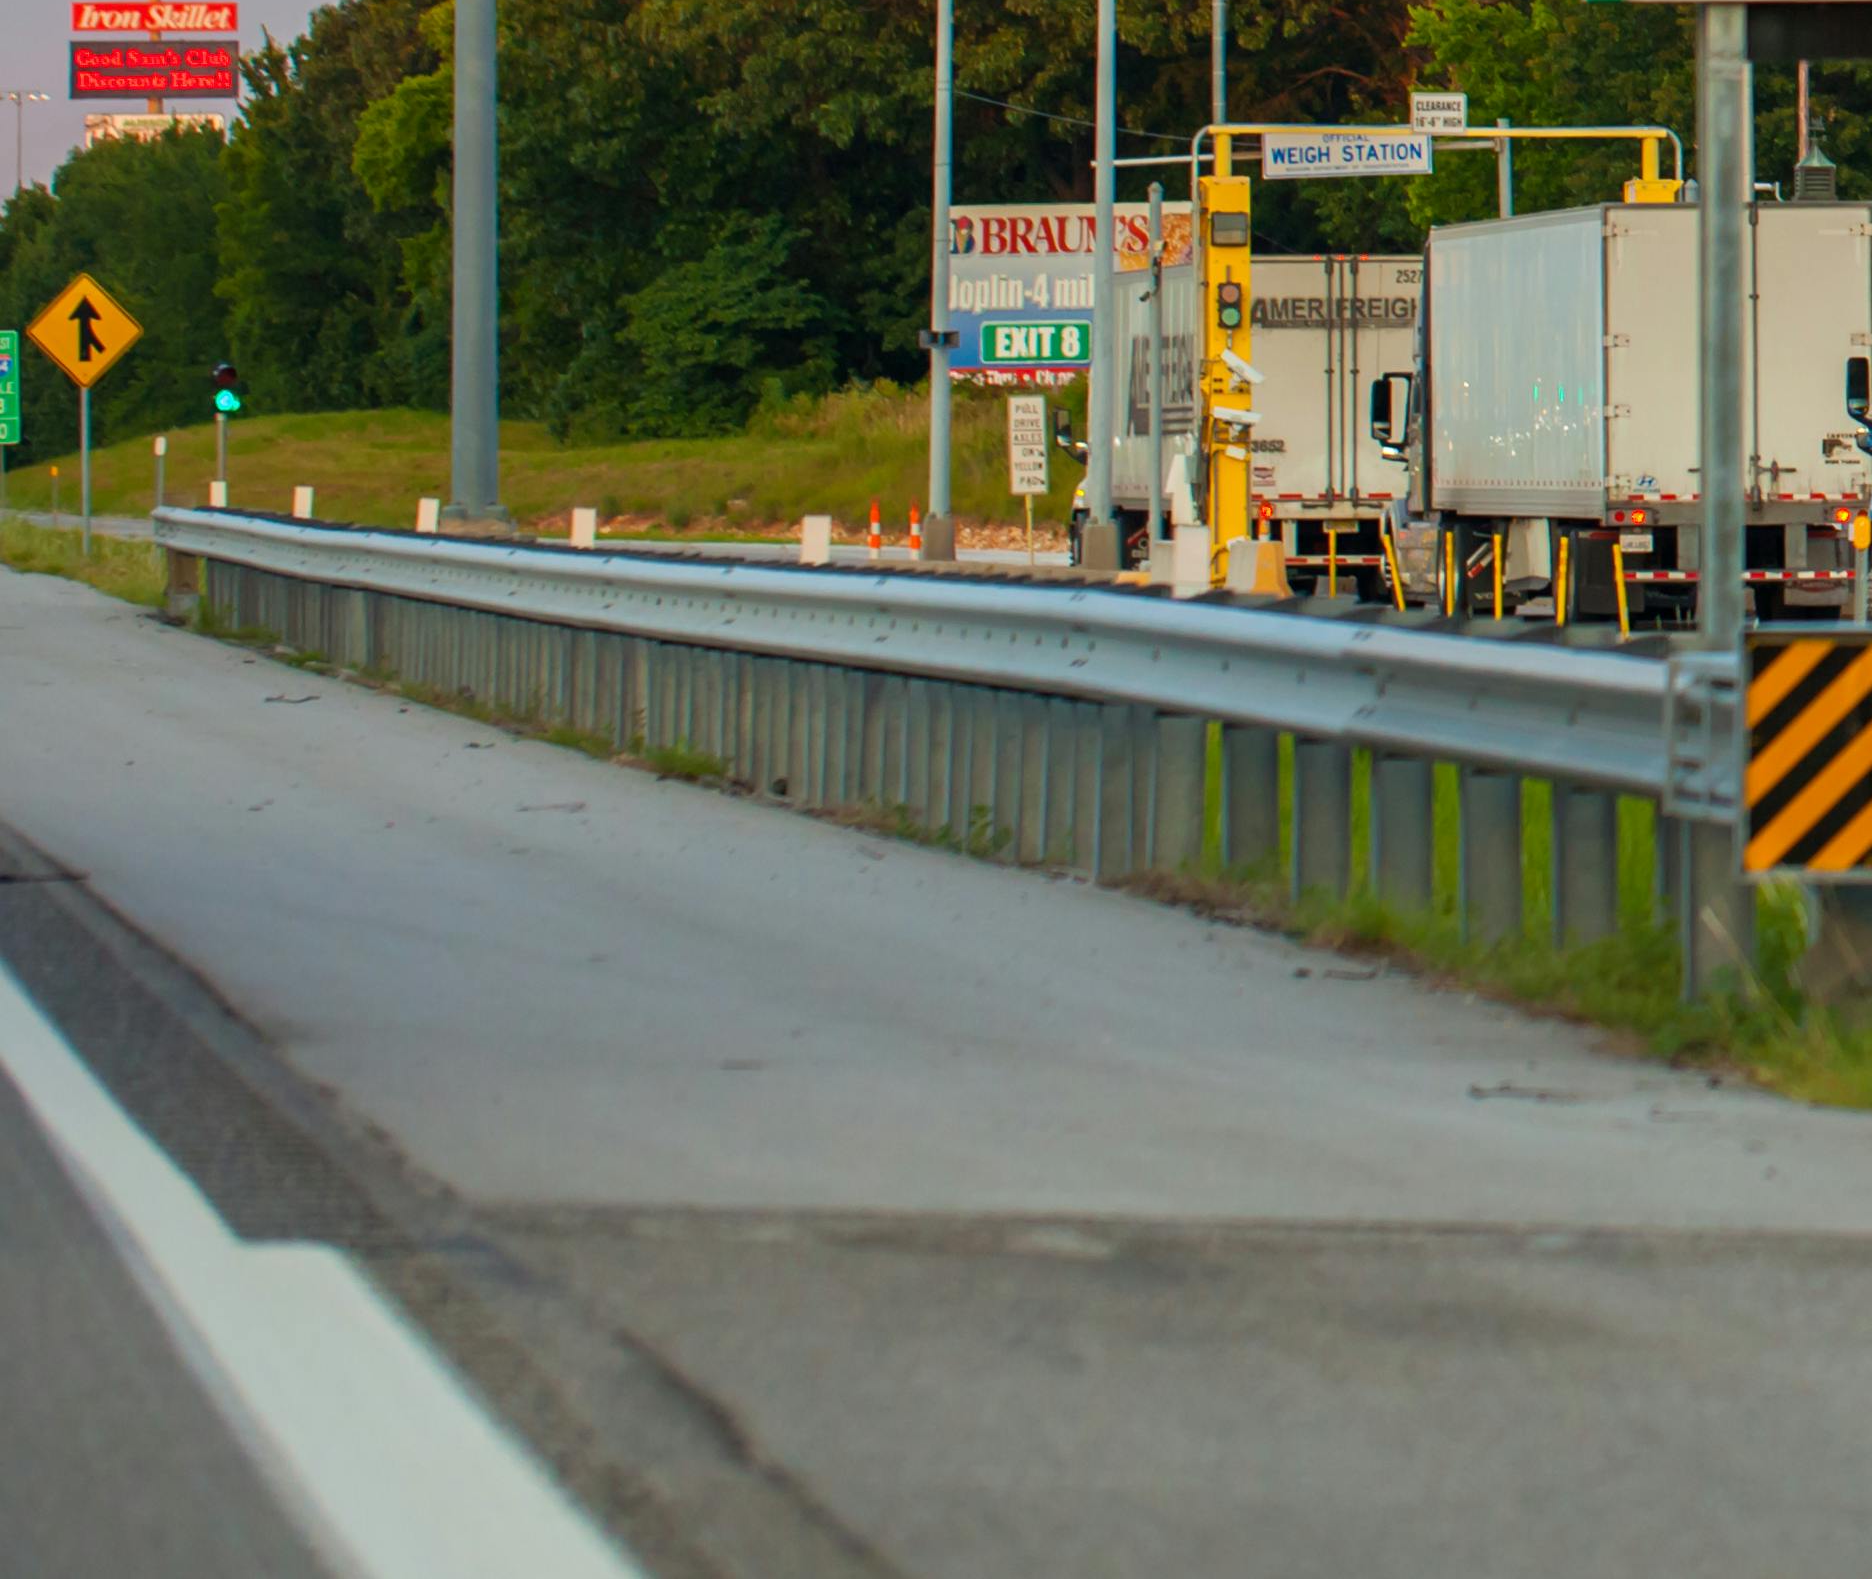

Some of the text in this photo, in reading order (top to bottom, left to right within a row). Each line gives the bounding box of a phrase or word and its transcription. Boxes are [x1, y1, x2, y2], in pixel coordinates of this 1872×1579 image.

[80, 4, 231, 29] Iron Skillet
[75, 50, 122, 68] Good
[185, 48, 231, 66] Club
[78, 70, 232, 90] Discounts Here!!
[1416, 101, 1461, 111] CLEARANCE
[1443, 117, 1462, 127] HIGH
[1322, 134, 1369, 143] OFFICIAL
[1272, 143, 1422, 164] WEIGH STATION
[995, 326, 1080, 358] EXIT 8
